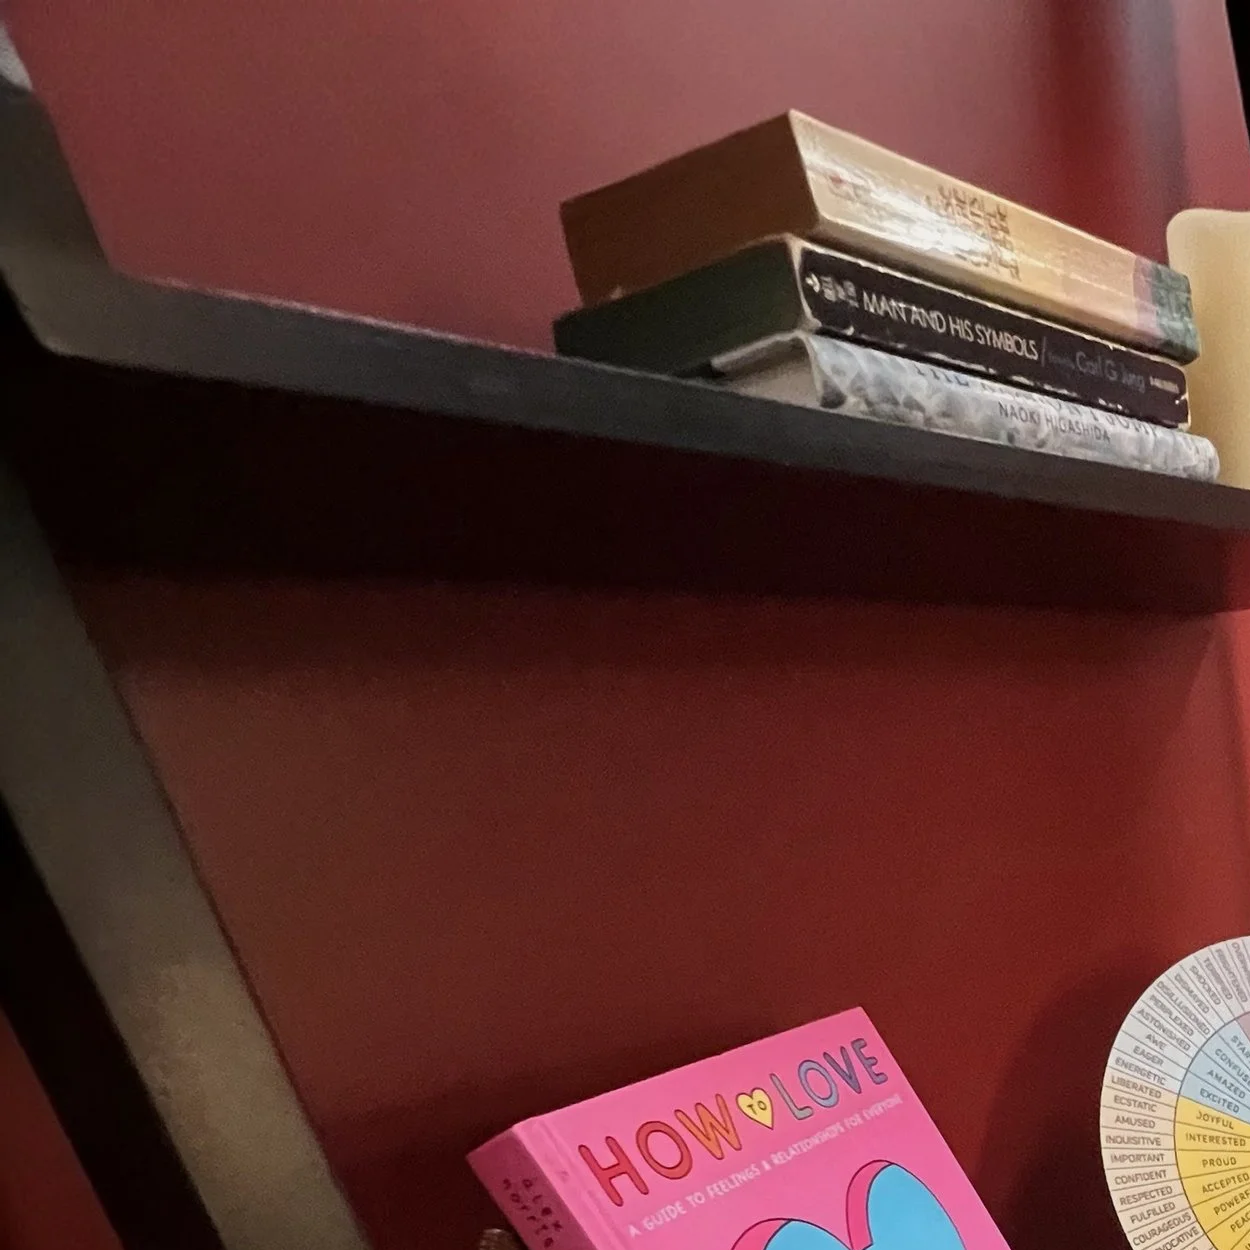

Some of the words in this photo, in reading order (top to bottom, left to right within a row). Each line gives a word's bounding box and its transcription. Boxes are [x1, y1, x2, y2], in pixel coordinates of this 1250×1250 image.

[863, 290, 908, 322] MAN
[911, 306, 946, 334] AND
[949, 315, 975, 342] HIS
[975, 322, 1038, 361] SYMBOLS
[1076, 351, 1104, 378] Carl
[999, 400, 1041, 424] NAOKI
[1046, 411, 1111, 444] HIGASHIDA
[1190, 965, 1221, 1005] SHOCKED
[1150, 995, 1194, 1036] PERPLEXED
[1138, 1009, 1190, 1051] ASTONISHED
[1146, 1034, 1166, 1050] AWE
[1133, 1046, 1164, 1066] EAGER
[1115, 1057, 1166, 1085] ENERGETIC
[1112, 1076, 1162, 1098] LIBERATED
[1207, 1070, 1246, 1099] AMAZED
[1114, 1095, 1157, 1112] ECSTATIC
[1200, 1089, 1239, 1113] EXCITED
[577, 1093, 743, 1207] HOW
[747, 1100, 769, 1116] TO
[769, 1037, 889, 1121] LOVE
[1115, 1115, 1155, 1129] AMUSED
[1196, 1110, 1235, 1130] JOYFUL
[1106, 1136, 1161, 1146] INQUISITIVE
[1186, 1133, 1246, 1147] INTERESTED
[628, 1225, 642, 1239] A
[643, 1204, 687, 1232] GUIDE
[686, 1191, 706, 1208] TO
[706, 1166, 761, 1200] FEELINGS
[771, 1122, 845, 1166] RELATIONSHIPS
[845, 1112, 864, 1130] FOR
[865, 1094, 904, 1121] EVERYONE
[1111, 1153, 1165, 1163] IMPORTANT
[1202, 1157, 1236, 1168] PROUD
[1115, 1170, 1167, 1185] CONFIDENT
[1202, 1173, 1250, 1194] ACCEPTED
[522, 1178, 563, 1232] alex
[1120, 1185, 1172, 1205] RESPECTED
[503, 1178, 554, 1248] norris
[1130, 1202, 1175, 1224] FULFILLED
[1133, 1213, 1192, 1247] COURAGEOUS
